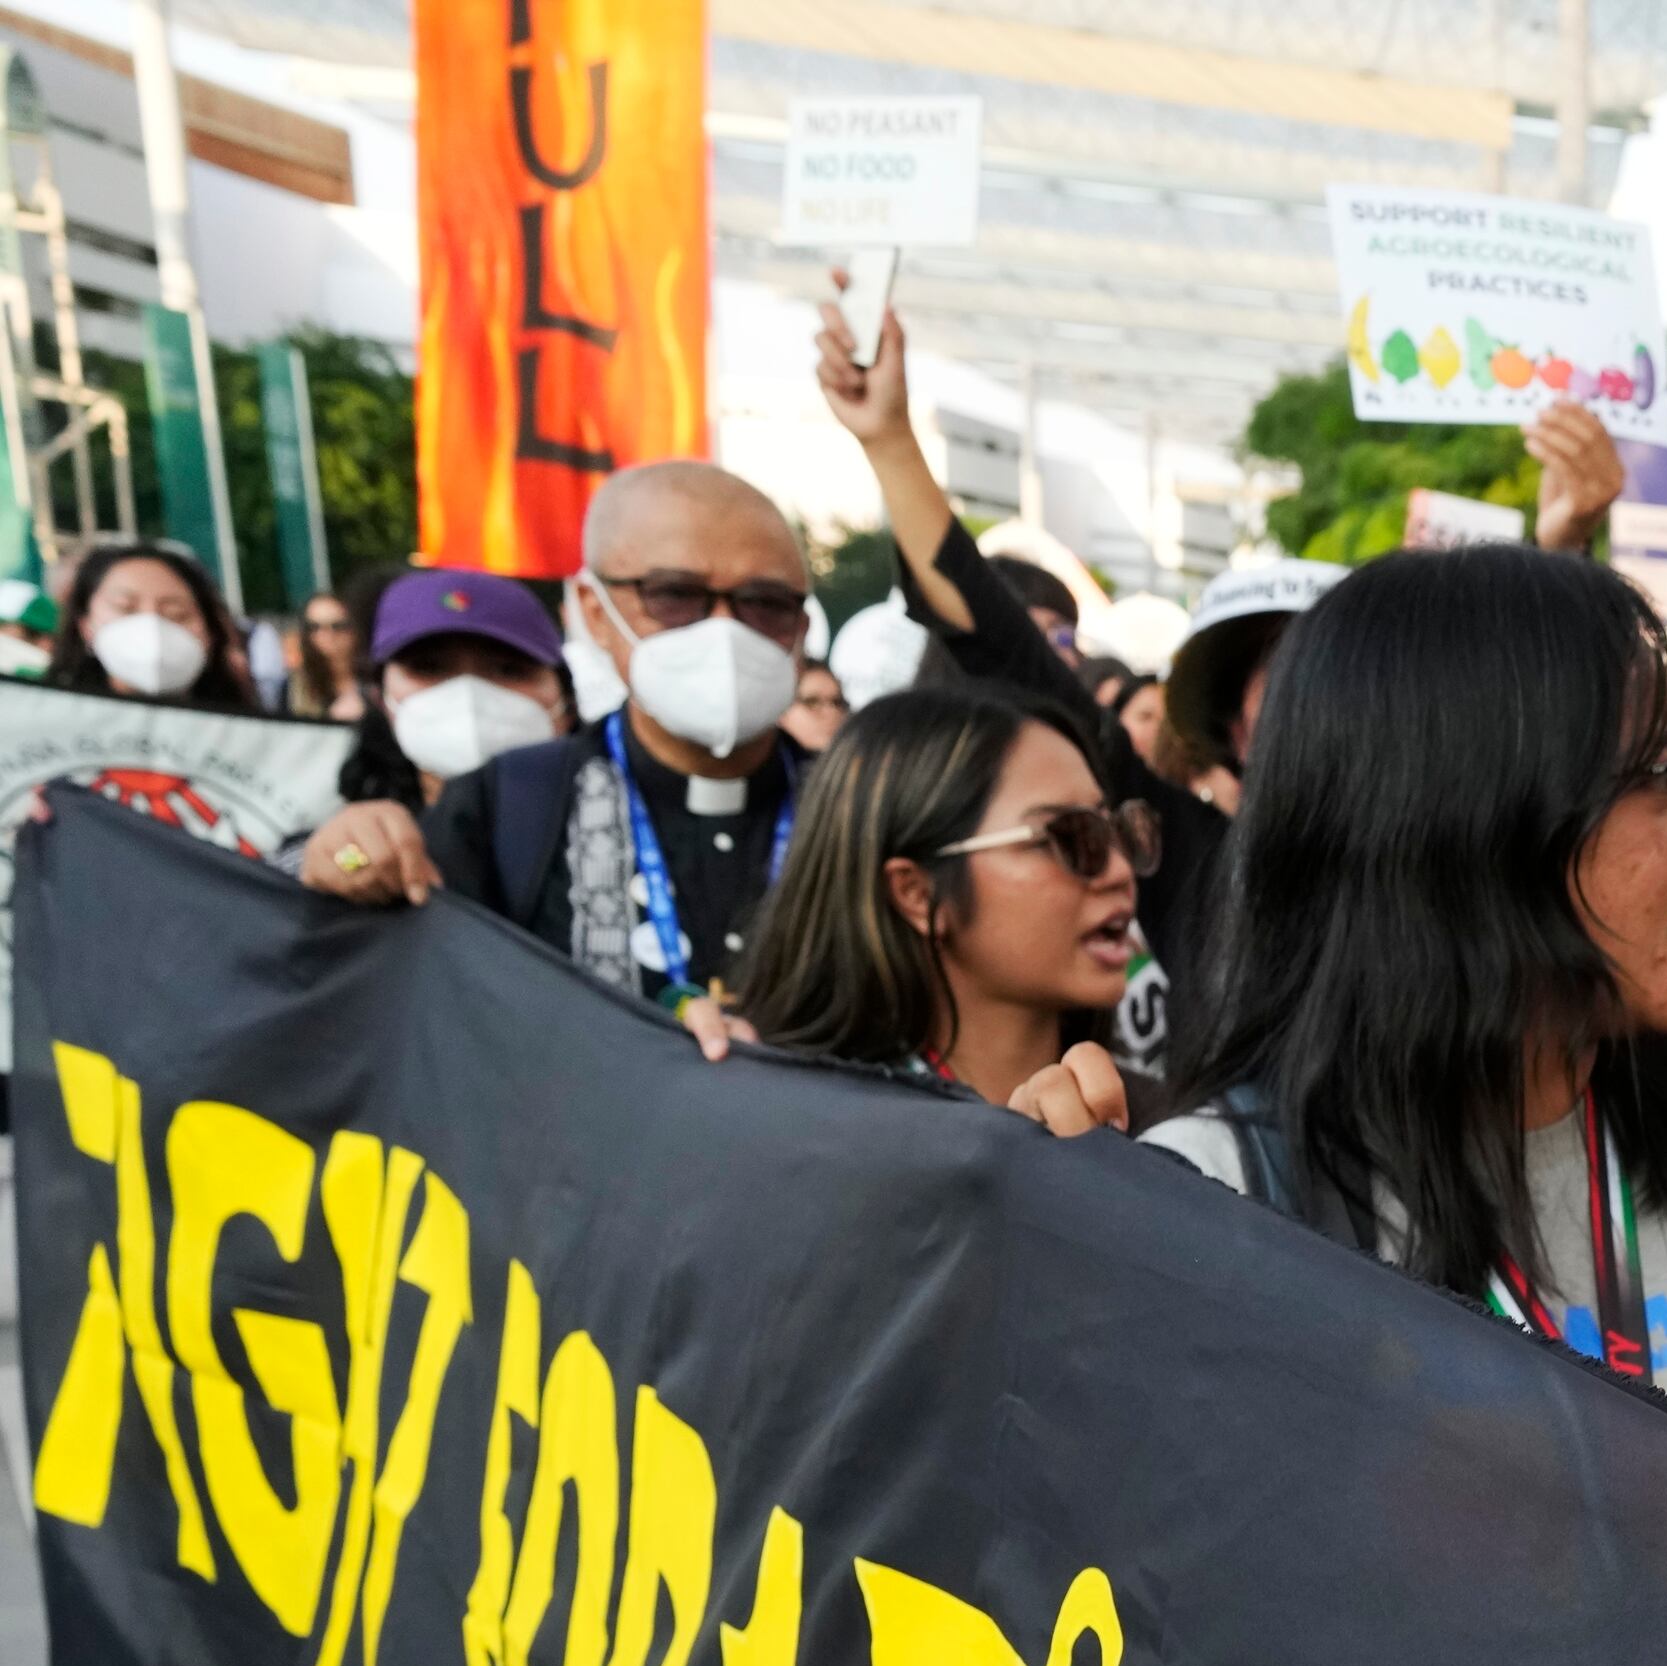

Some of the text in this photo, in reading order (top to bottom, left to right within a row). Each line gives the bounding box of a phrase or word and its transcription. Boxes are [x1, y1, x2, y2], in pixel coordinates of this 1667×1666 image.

[802, 151, 918, 182] NO FOOD
[508, 0, 616, 473] ULL
[1350, 199, 1638, 251] SUPPORT RESILIENT
[1367, 233, 1634, 283] AGROECOLOGICAL
[1426, 270, 1590, 306] PRACTICES
